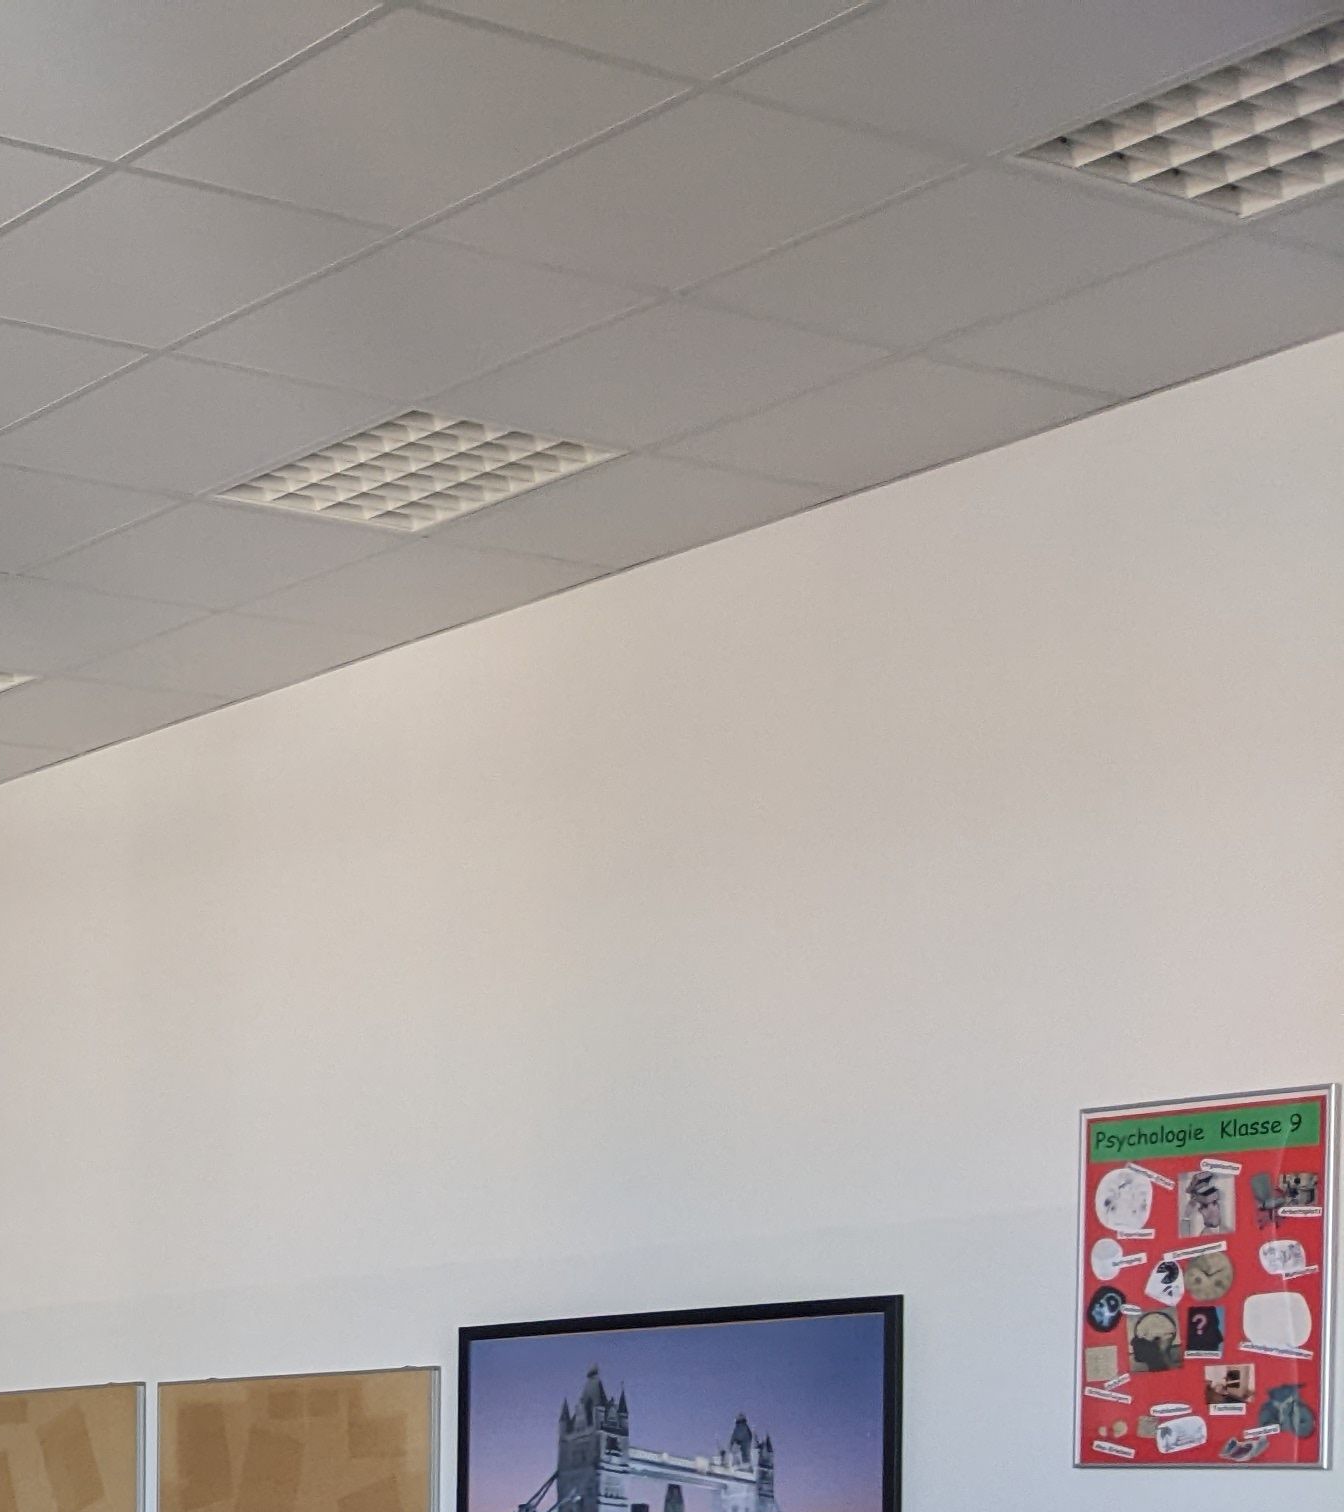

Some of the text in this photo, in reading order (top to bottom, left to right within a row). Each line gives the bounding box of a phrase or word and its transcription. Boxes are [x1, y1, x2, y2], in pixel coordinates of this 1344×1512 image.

[1095, 1113, 1302, 1152] Psychologie Klasse 9
